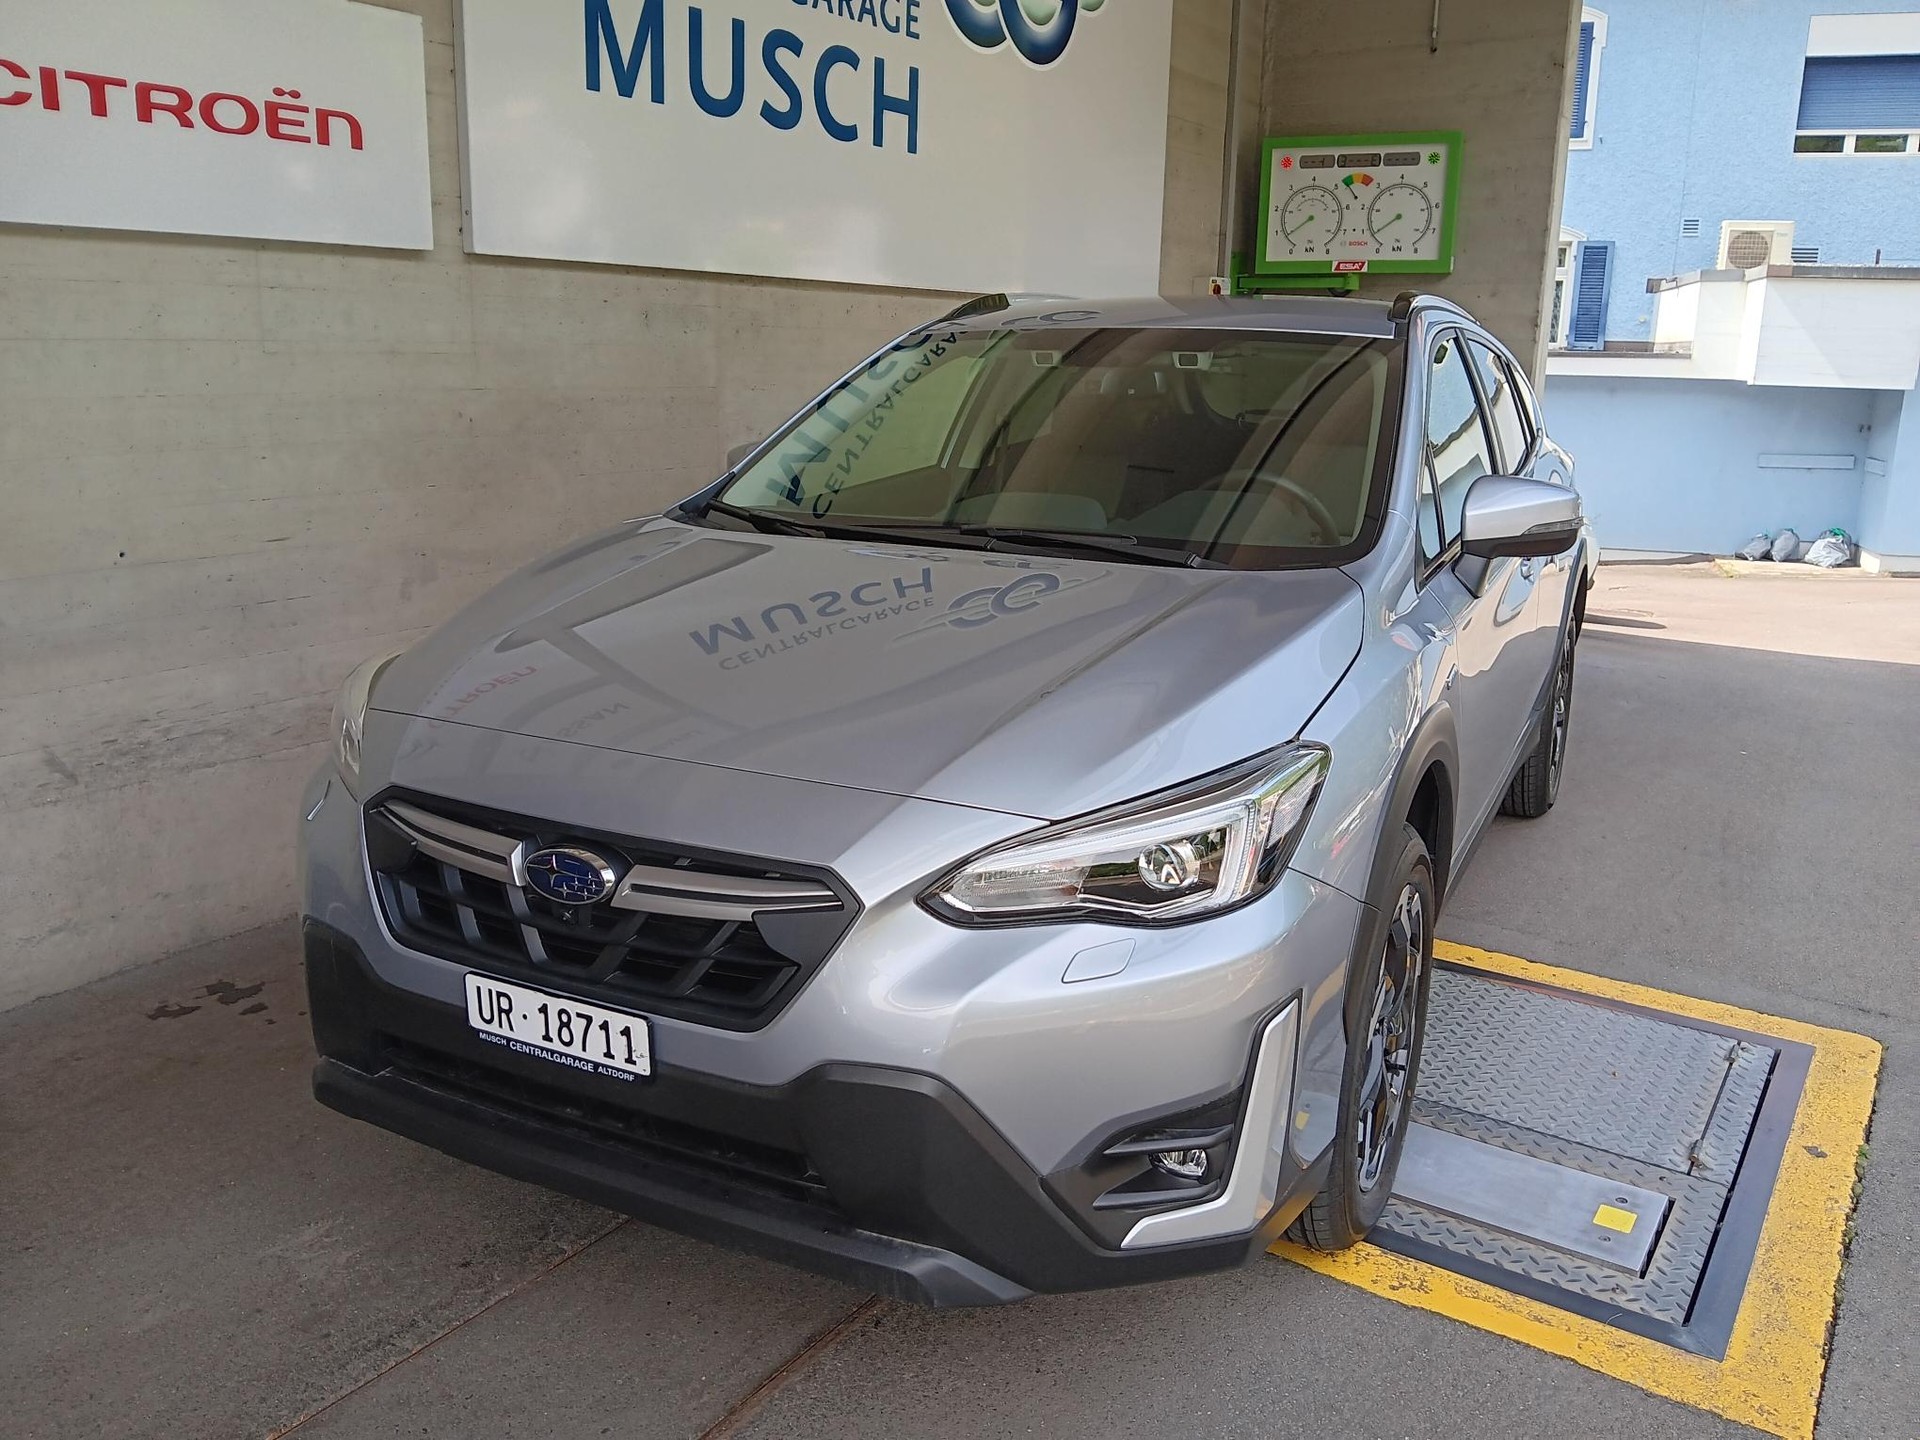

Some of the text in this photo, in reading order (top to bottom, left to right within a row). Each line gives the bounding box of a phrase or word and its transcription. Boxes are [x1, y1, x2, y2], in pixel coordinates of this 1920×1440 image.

[585, 0, 920, 154] MUSCH
[479, 1031, 636, 1082] MUSCH CENTRALGARAGE ALTDORF
